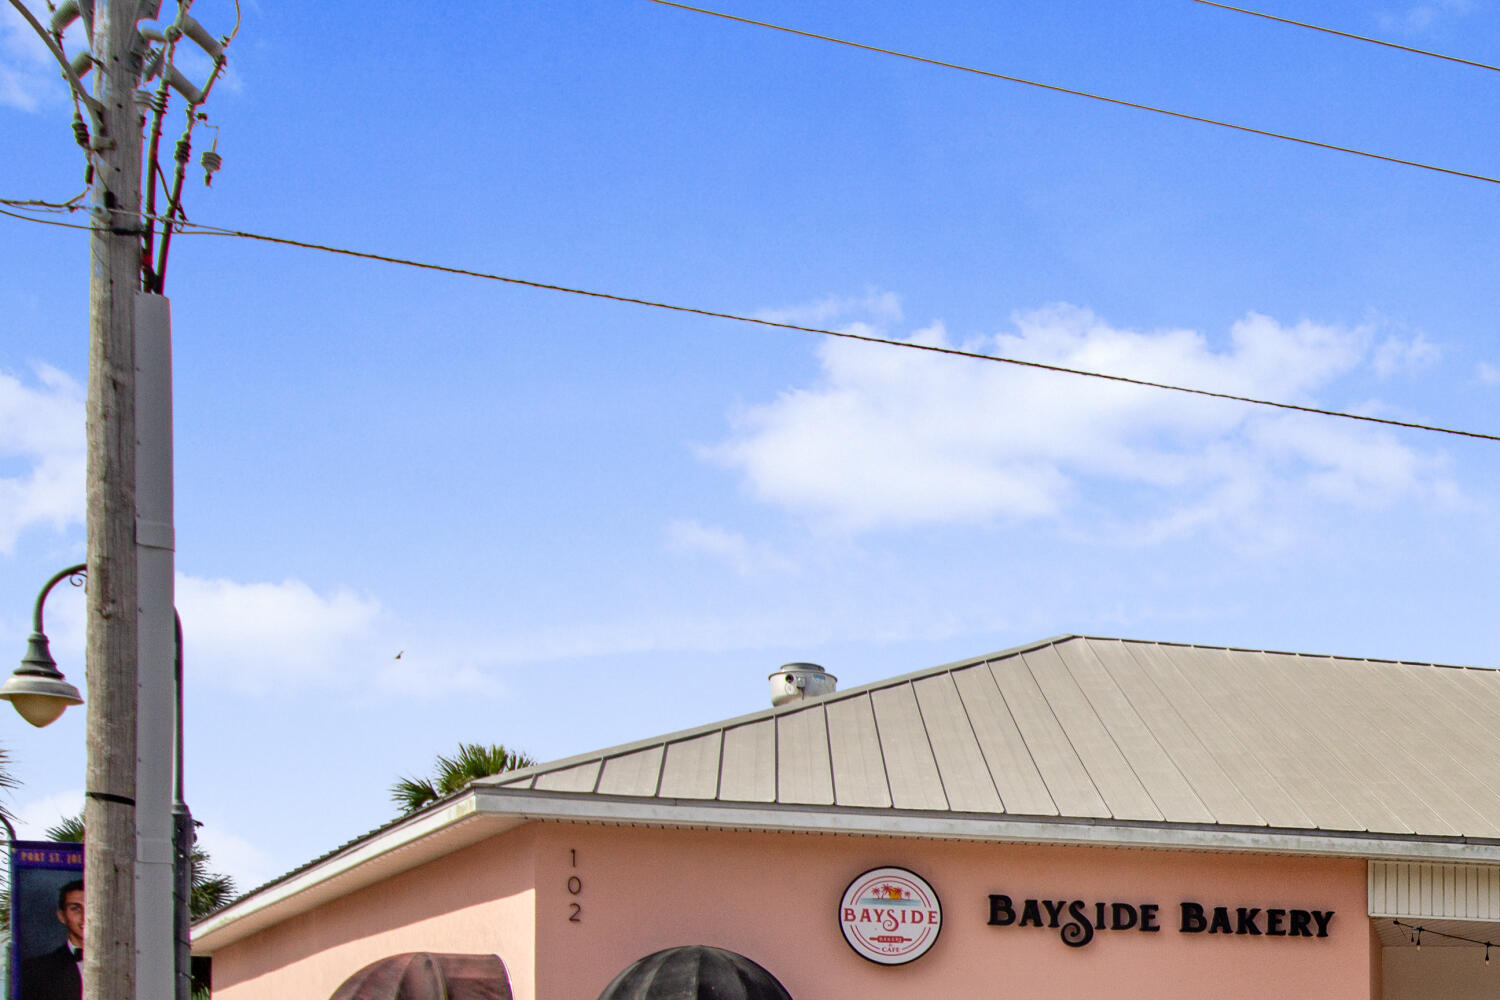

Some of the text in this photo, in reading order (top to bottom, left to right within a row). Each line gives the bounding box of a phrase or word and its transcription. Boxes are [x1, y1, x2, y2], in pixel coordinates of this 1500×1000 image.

[567, 848, 581, 922] 102
[844, 908, 937, 931] BAYSIDE
[987, 895, 1335, 947] BAYSIDE BAKERY
